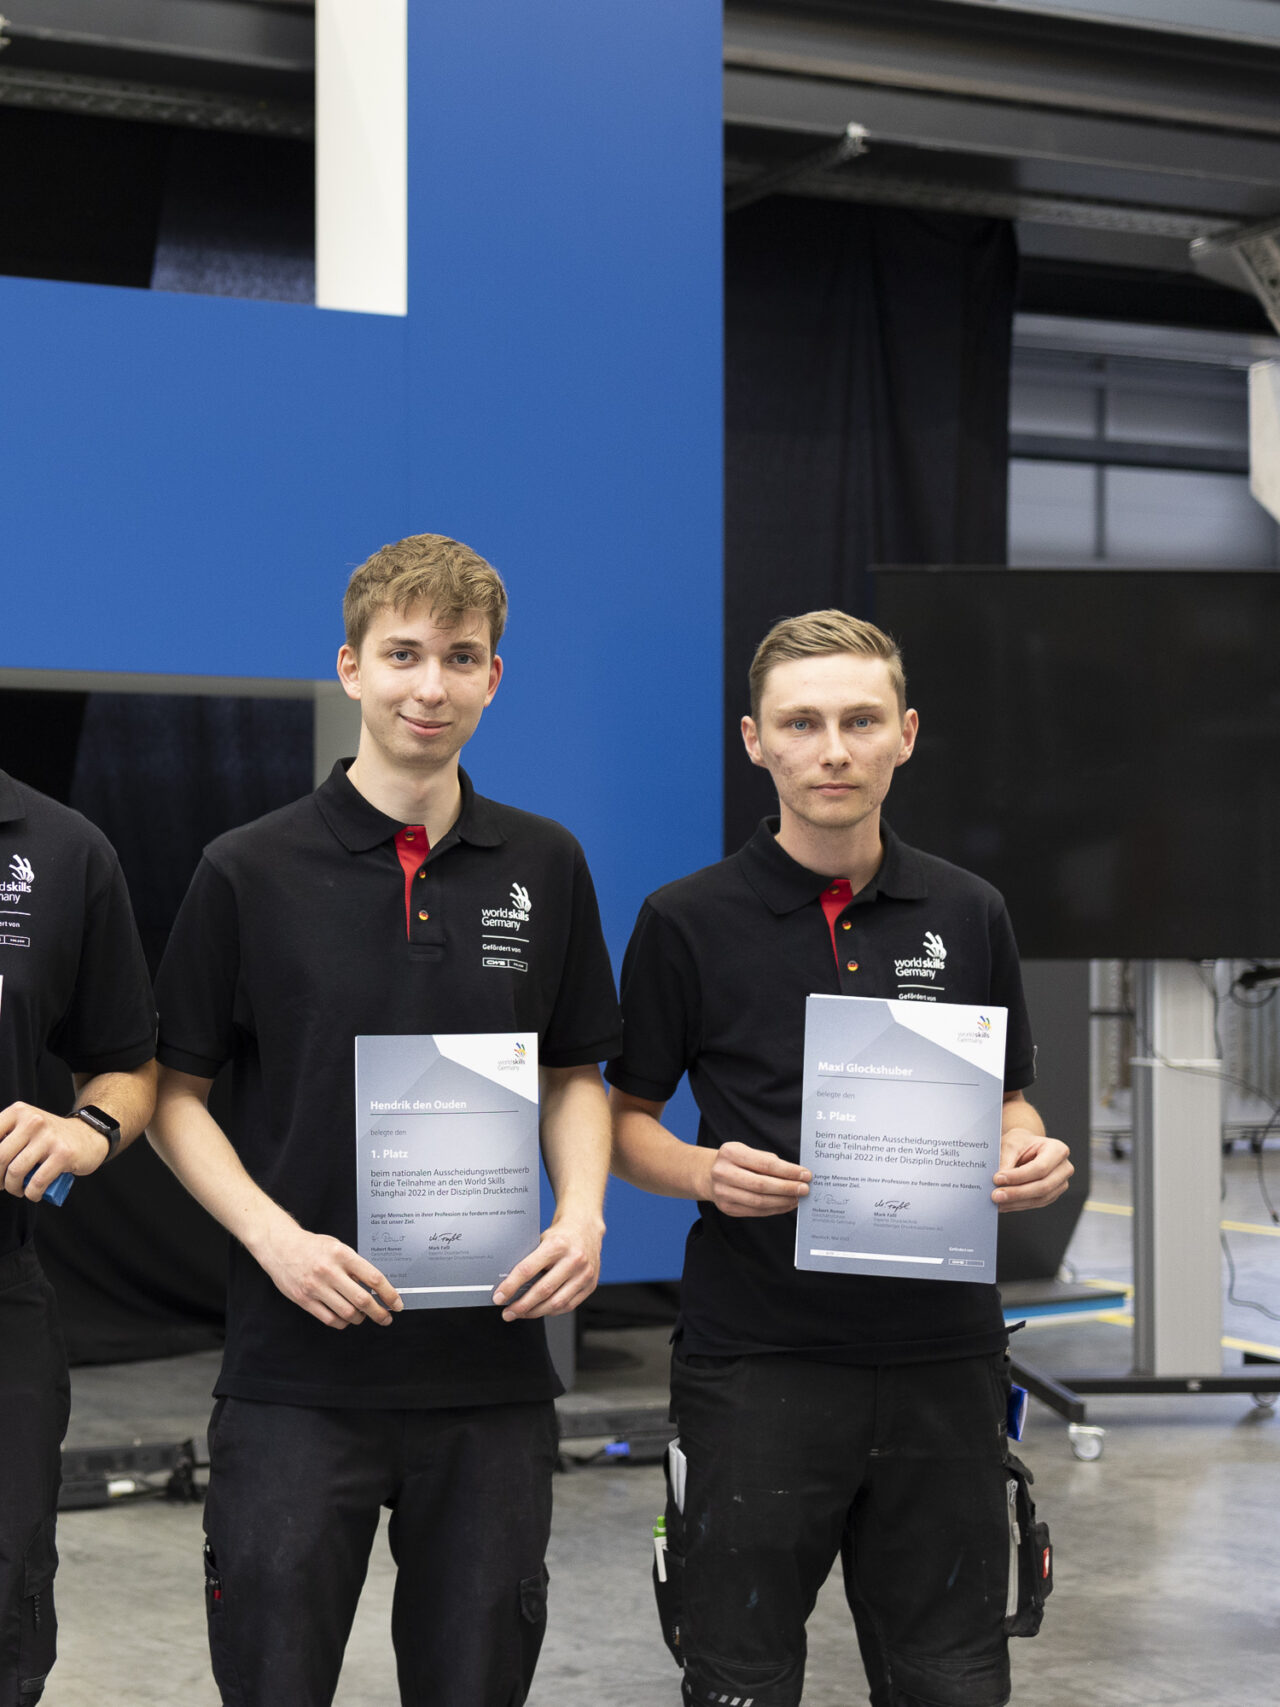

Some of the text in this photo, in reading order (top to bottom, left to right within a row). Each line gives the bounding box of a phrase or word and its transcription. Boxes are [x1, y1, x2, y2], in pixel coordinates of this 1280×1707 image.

[482, 908, 529, 921] worldskills
[482, 917, 520, 931] Germany
[894, 957, 945, 969] worldskills
[895, 967, 936, 980] Germany
[818, 1062, 913, 1076] Maxi Glockshuber
[817, 1091, 841, 1099] belegte
[370, 1100, 467, 1110] Hendrik den Ouden
[816, 1111, 856, 1122] 3. Platz
[816, 1131, 989, 1149] beim nationalen Ausscheidungswettbewerb
[371, 1149, 408, 1159] 1. Platz
[843, 1142, 884, 1152] Teilnahme
[898, 1146, 913, 1154] den
[915, 1147, 939, 1156] World
[940, 1148, 960, 1157] Skills
[815, 1150, 853, 1161] Shanghai
[854, 1153, 873, 1162] 2022
[885, 1155, 898, 1163] der
[900, 1156, 933, 1166] Disziplin
[935, 1158, 987, 1168] Drucktechnik
[392, 1169, 432, 1177] nationalen
[434, 1166, 530, 1176] Ausscheidungswettbewerb
[371, 1179, 382, 1187] für
[383, 1179, 395, 1187] die
[397, 1178, 436, 1186] Teilnahme
[449, 1178, 463, 1186] den
[464, 1177, 486, 1186] World
[488, 1177, 505, 1185] Skills
[371, 1189, 406, 1199] Shanghai
[451, 1188, 482, 1197] Disziplin
[483, 1186, 528, 1195] Drucktechnik
